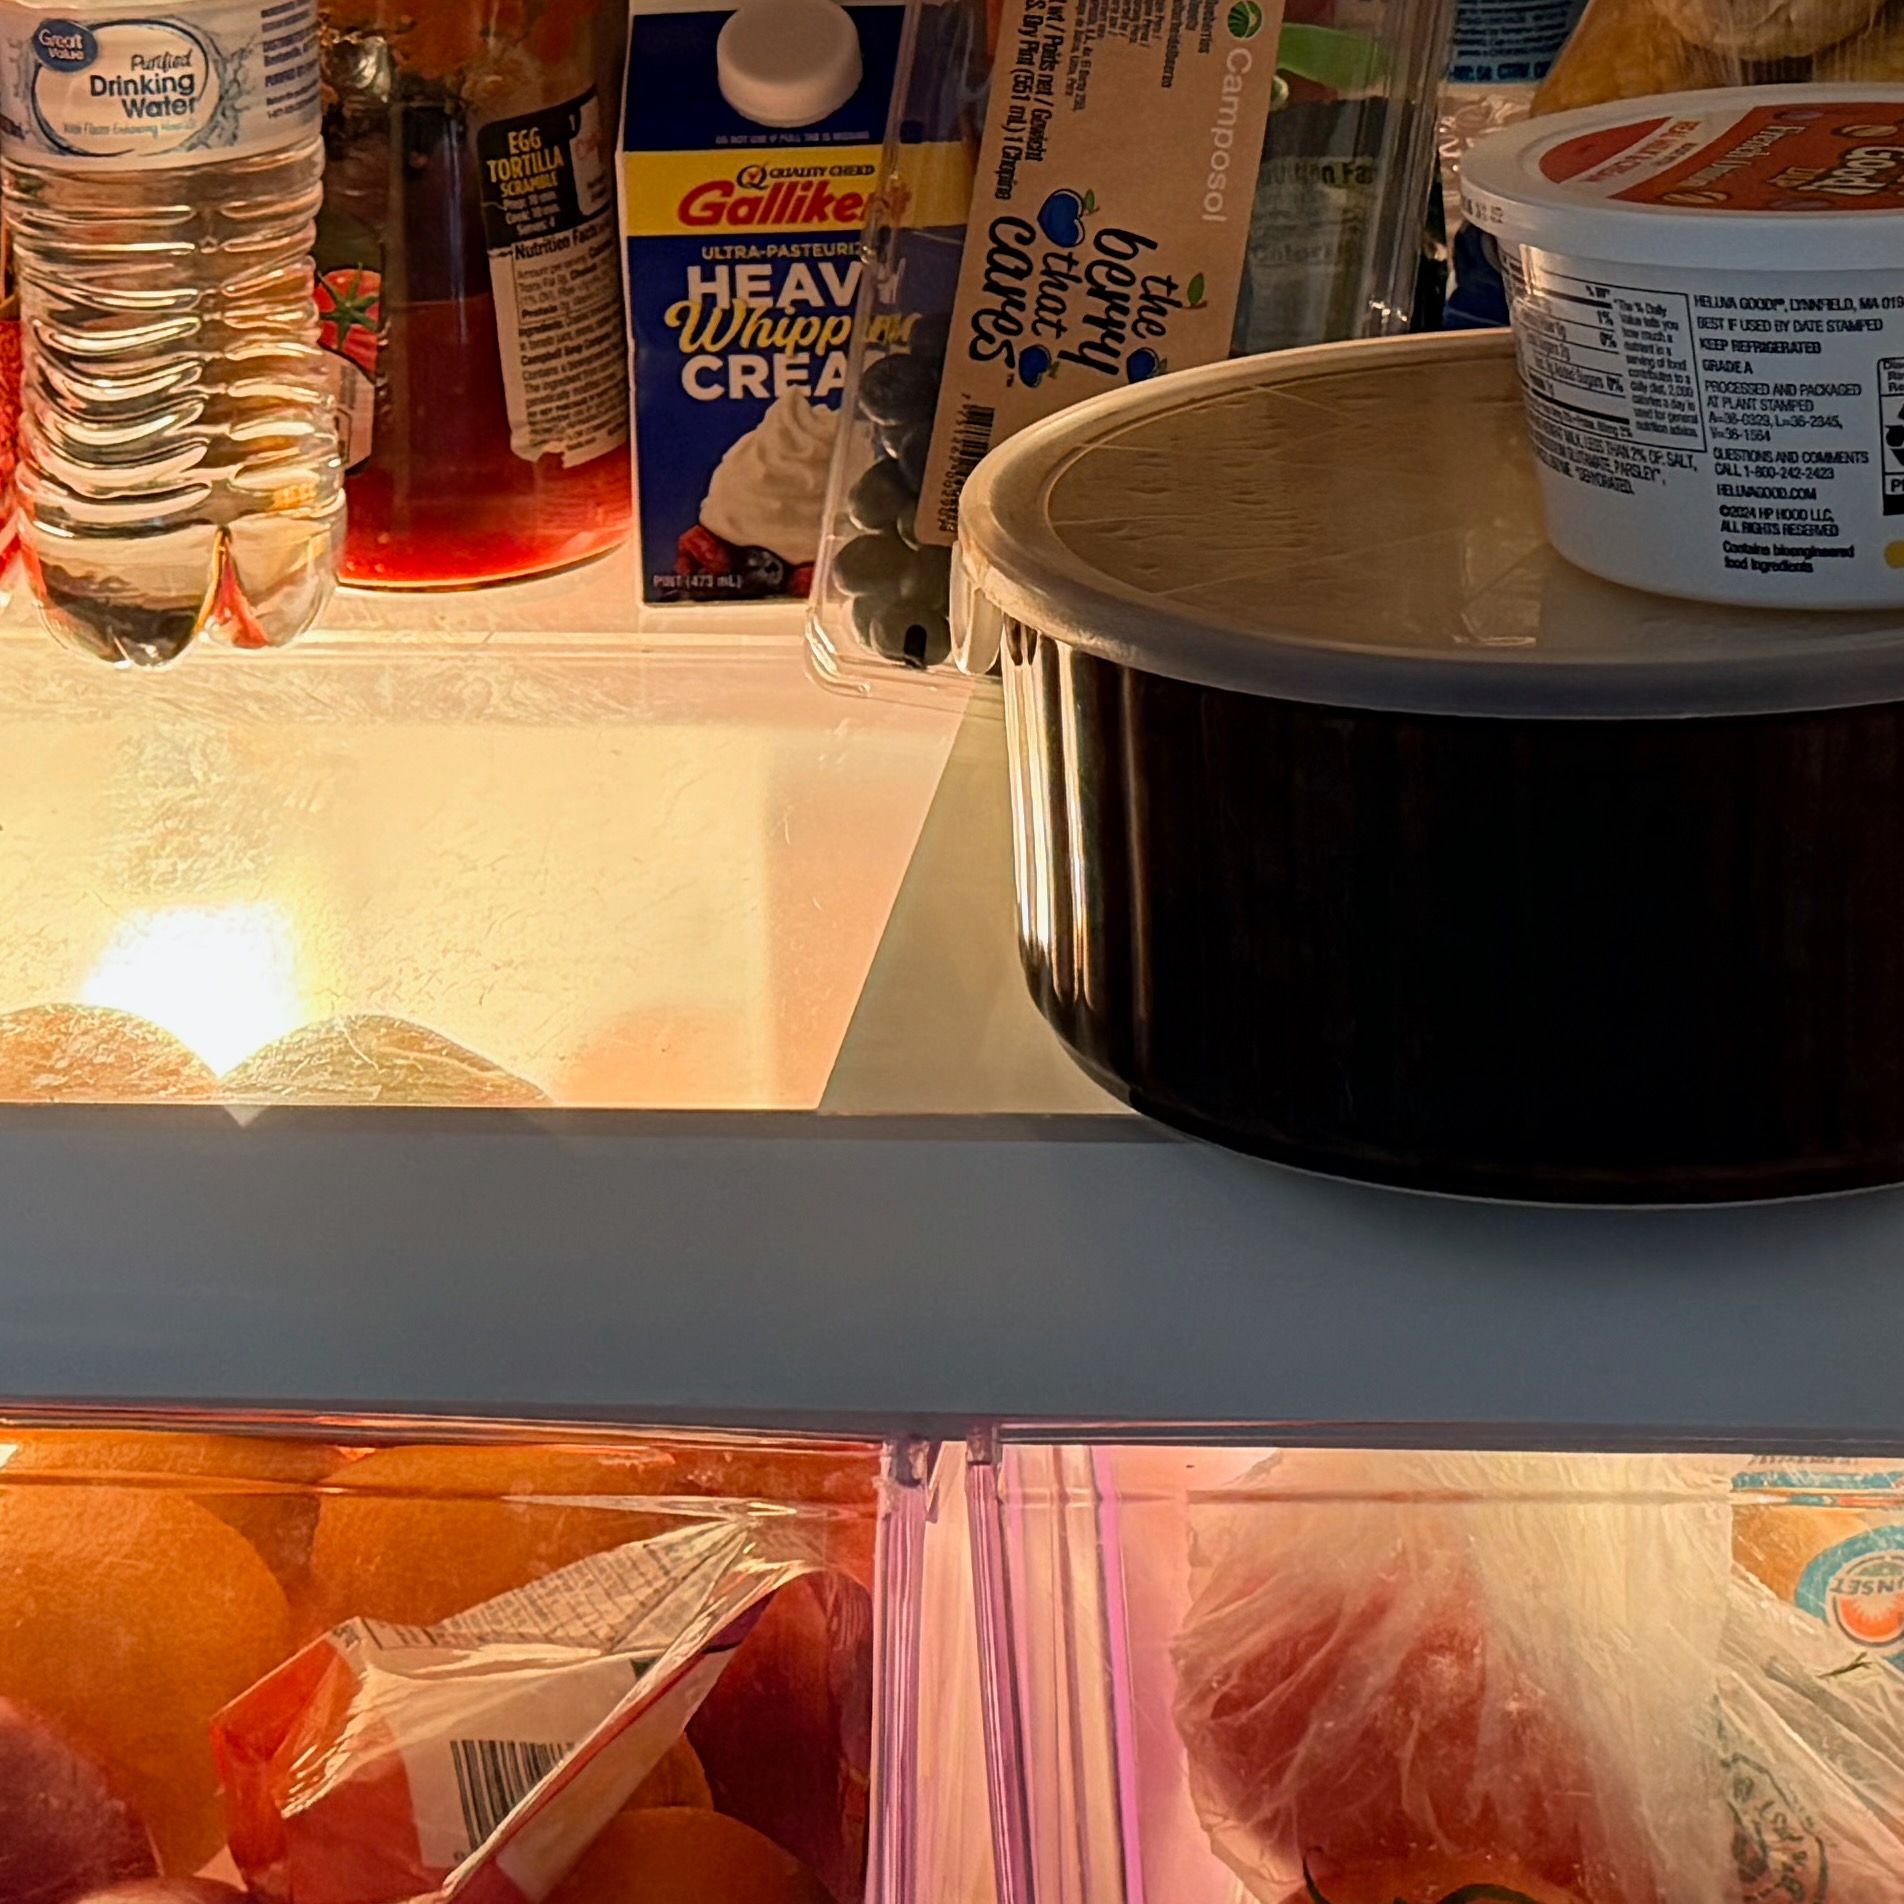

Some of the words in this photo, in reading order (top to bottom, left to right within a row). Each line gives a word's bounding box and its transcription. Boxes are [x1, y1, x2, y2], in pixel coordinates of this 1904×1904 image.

[1046, 6, 1065, 22] wt
[1018, 15, 1044, 36] Dry
[39, 28, 83, 49] Great
[48, 47, 85, 61] Value
[131, 49, 192, 72] Purified
[1016, 40, 1038, 65] Pint
[1041, 35, 1063, 71] Poids
[89, 73, 195, 99] Drinking
[1010, 69, 1033, 100] (551
[1035, 75, 1058, 96] net
[121, 97, 196, 119] Water
[1002, 105, 1029, 132] mL)
[508, 127, 542, 155] EGG
[1025, 109, 1053, 162] Gewicht
[1201, 47, 1253, 223] Camposol
[487, 146, 564, 183] TORTILLA
[770, 166, 826, 178] QUALITY
[993, 145, 1024, 200] Chopine
[500, 171, 558, 195] SCRAMBLE
[515, 237, 570, 260] Nutrition
[701, 242, 866, 260] ULTRA-PASTEURIZ
[968, 215, 1037, 369] cares
[1031, 251, 1082, 342] that
[1057, 227, 1158, 376] berry
[1695, 295, 1737, 309] HELUVA
[1859, 298, 1879, 309] MA
[1134, 274, 1182, 339] the
[1662, 320, 1679, 331] you
[1697, 317, 1724, 330] BEST
[1728, 319, 1738, 331] IF
[1740, 319, 1771, 331] USED
[1775, 320, 1789, 332] BY
[1793, 320, 1824, 332] DATE
[1827, 319, 1882, 331] STAMPED
[1700, 339, 1728, 351] KEEP
[1732, 341, 1821, 354] REFRIGERATED
[681, 351, 862, 401] CREA
[1703, 359, 1739, 373] GRADE
[1741, 363, 1753, 374] A
[1669, 385, 1693, 397] 2,000
[1705, 380, 1769, 395] PROCESSED
[1773, 383, 1796, 395] AND
[1800, 384, 1861, 396] PACKAGED
[1707, 396, 1720, 409] AT
[1723, 397, 1755, 410] PLANT
[1761, 399, 1814, 412] STAMPED
[1667, 451, 1697, 471] SALT,
[1713, 447, 1773, 463] QUESTIONS
[1776, 451, 1799, 463] AND
[1802, 451, 1869, 464] COMMENTS
[1715, 463, 1741, 477] CALL
[1745, 465, 1834, 479] 1-800-242-2423
[1759, 506, 1774, 519] HP
[1776, 508, 1808, 520] HOOD
[1721, 521, 1740, 532] ALL
[1742, 521, 1780, 535] RIGHTS
[1783, 523, 1839, 536] RESERVED
[1723, 540, 1770, 555] Contains
[1773, 544, 1854, 560] bioengineered
[1725, 558, 1748, 569] food
[1751, 559, 1813, 573] ingredients
